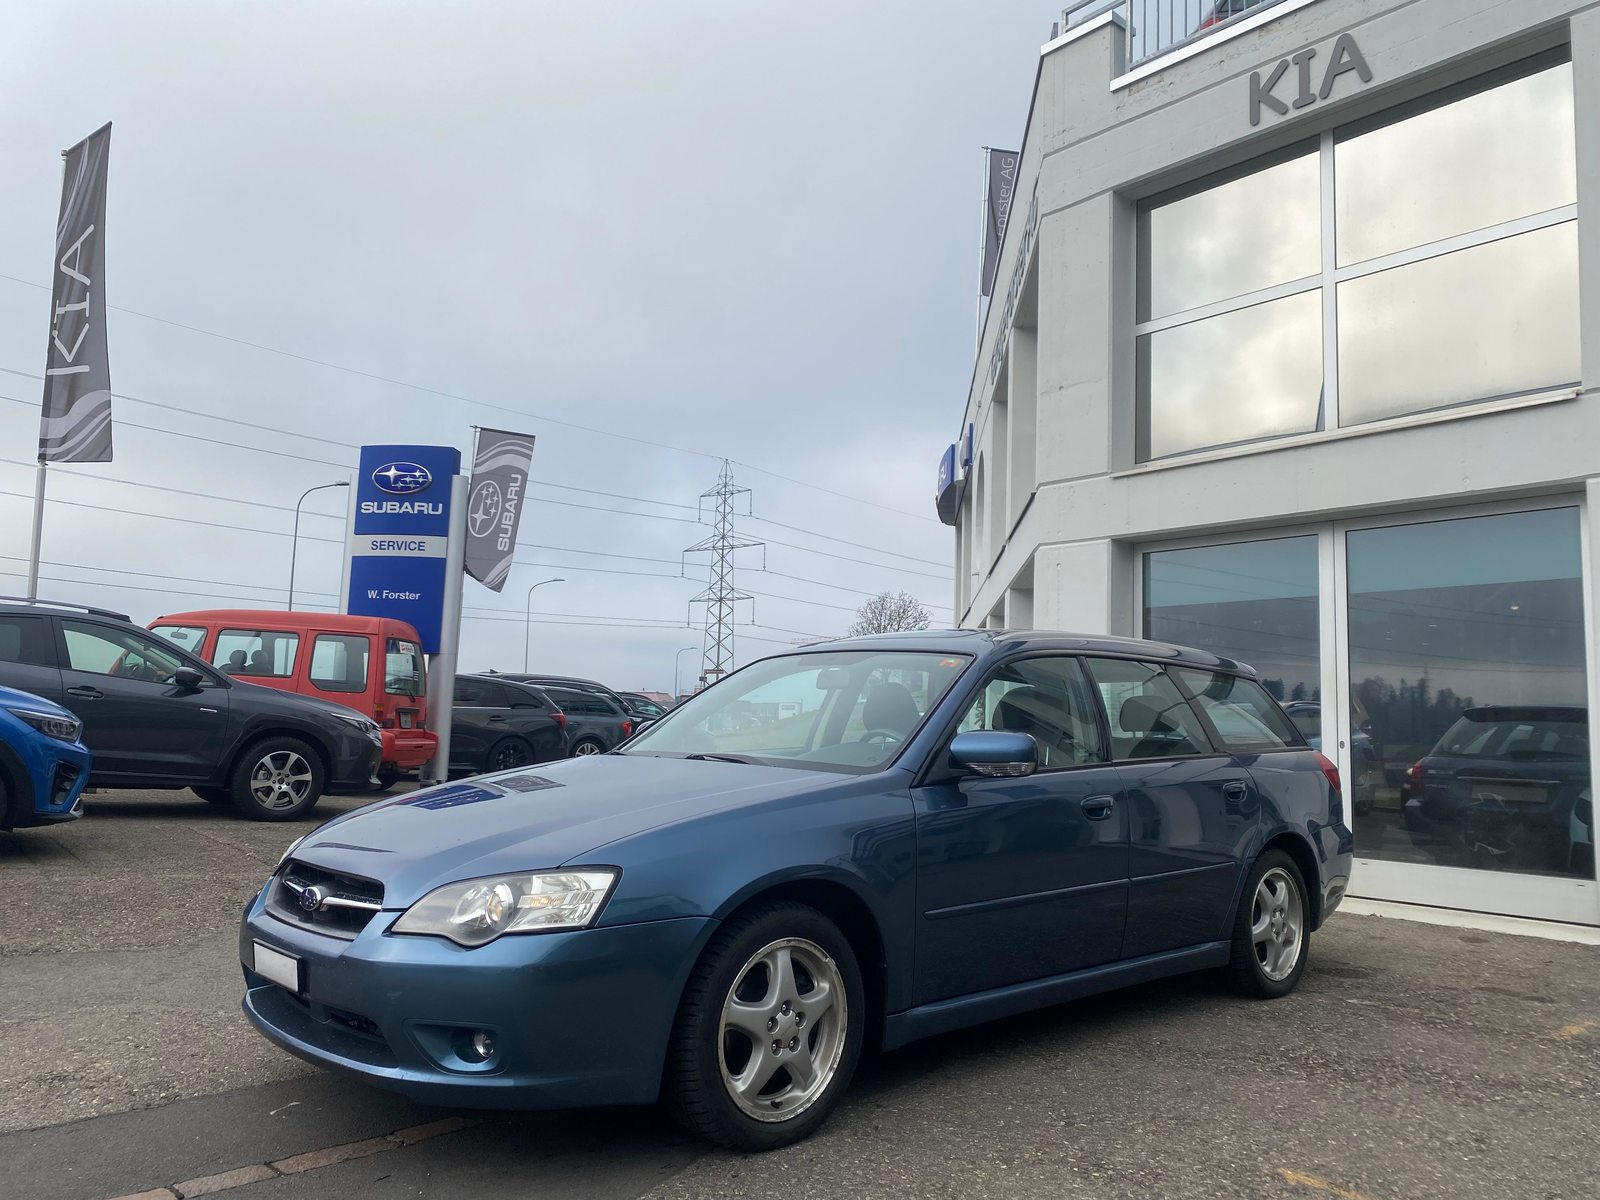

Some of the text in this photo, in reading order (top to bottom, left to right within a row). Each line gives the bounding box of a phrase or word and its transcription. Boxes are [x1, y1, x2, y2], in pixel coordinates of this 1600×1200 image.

[1249, 33, 1373, 126] KIA
[1001, 157, 1014, 180] AG
[47, 224, 95, 376] KIA
[360, 501, 443, 515] SUBARU
[497, 473, 522, 552] SUBARU
[370, 540, 426, 552] SERVICE
[367, 590, 421, 600] W. Forster
